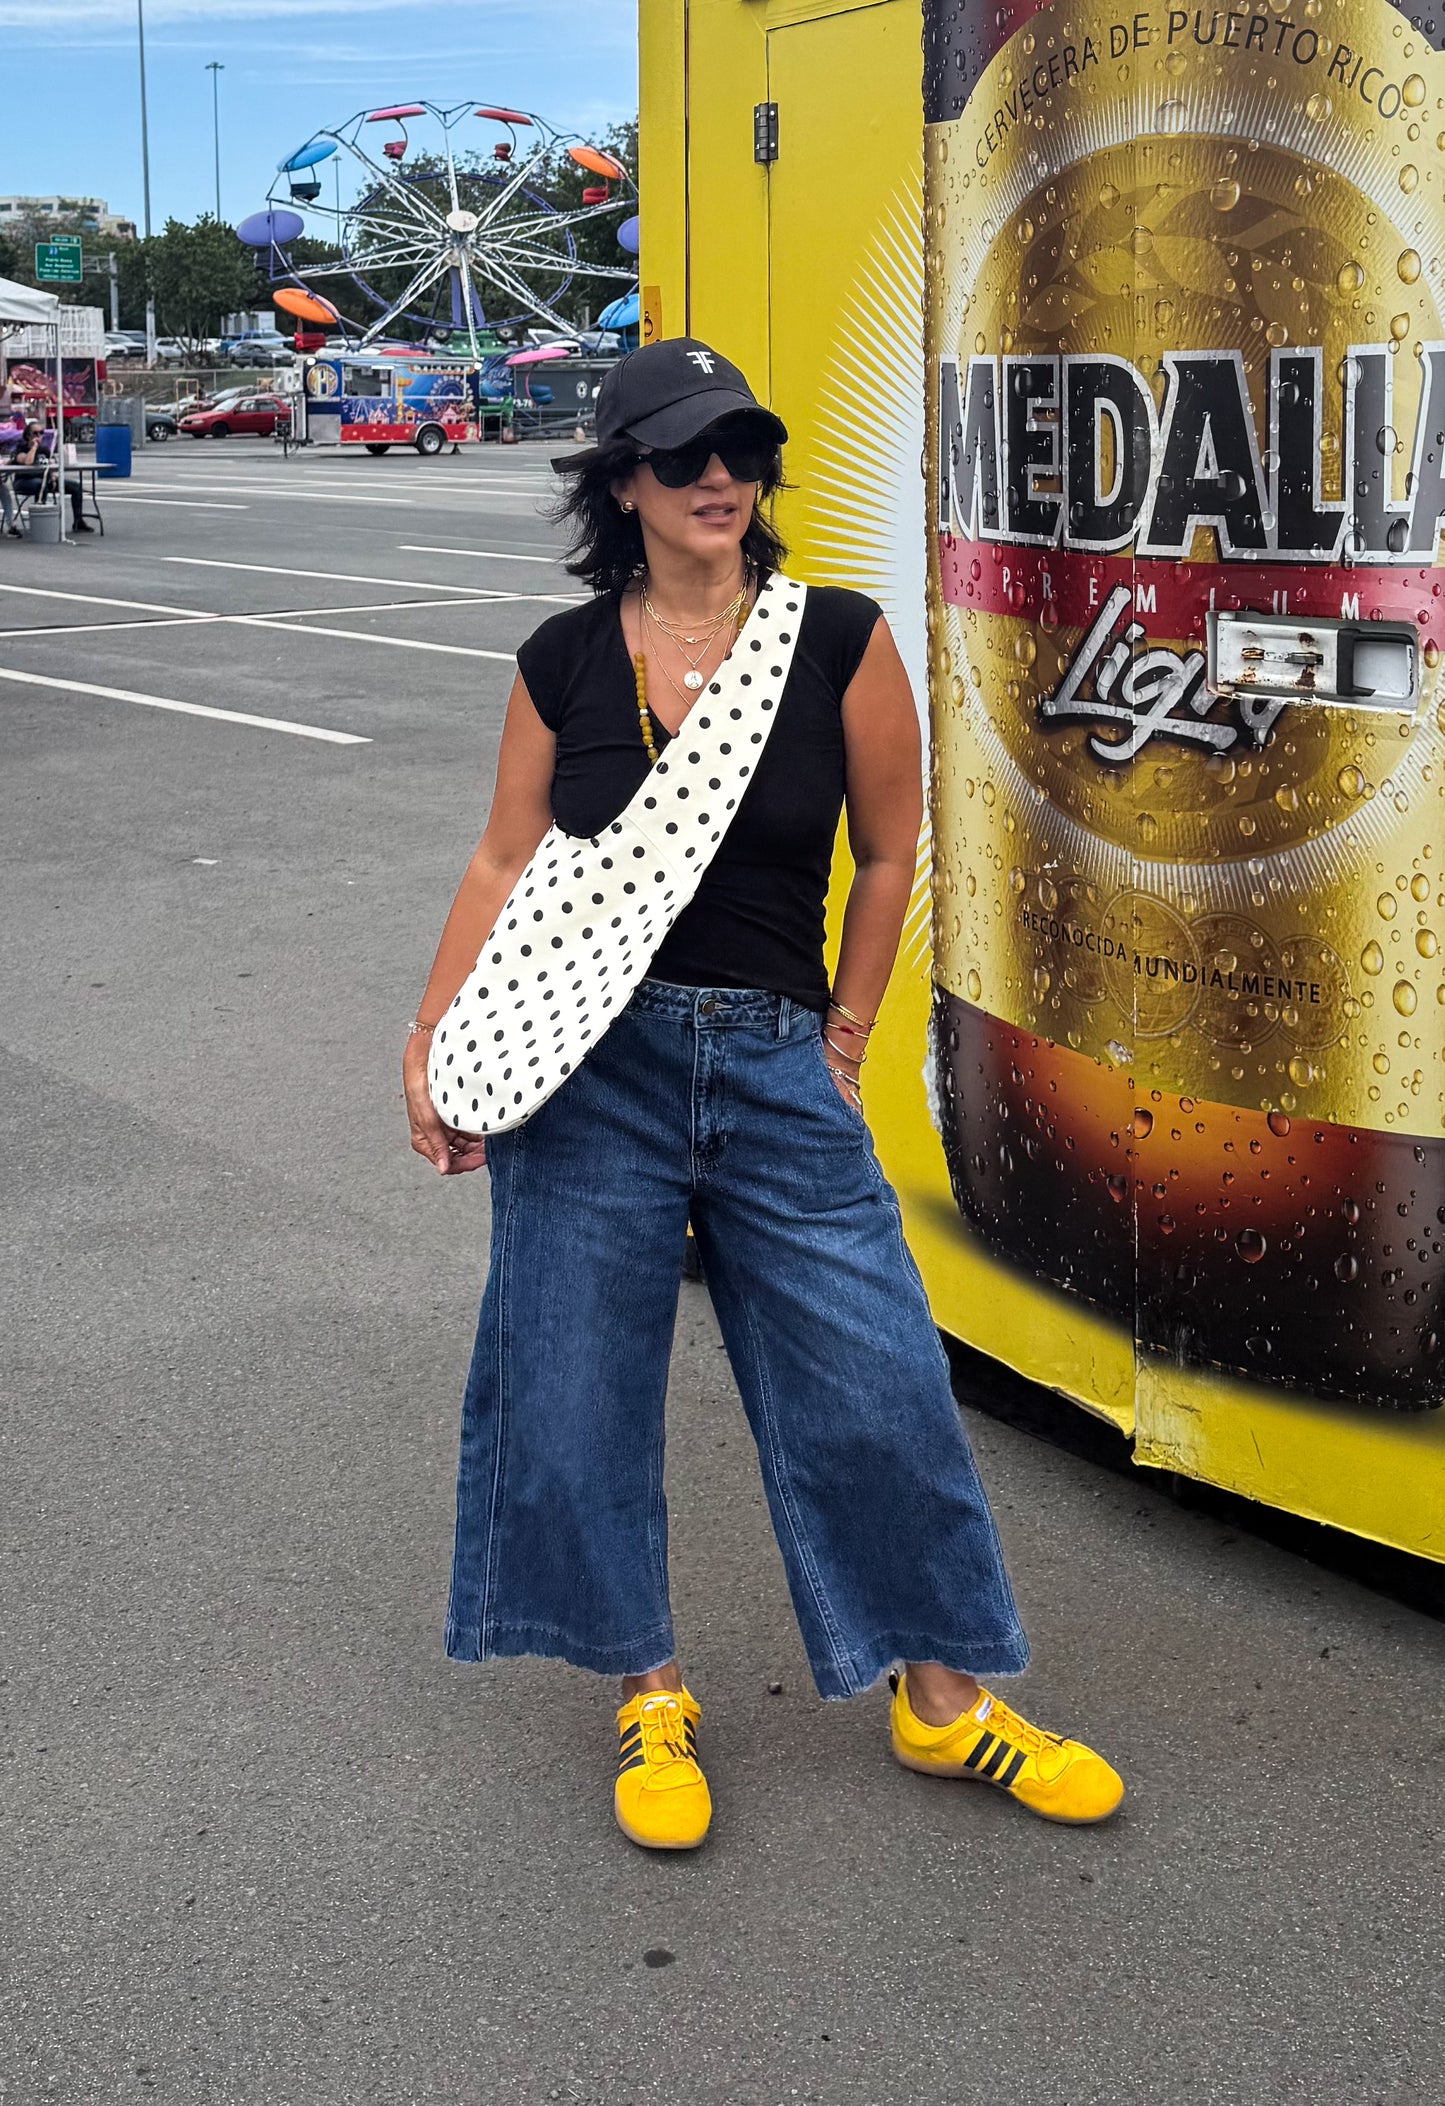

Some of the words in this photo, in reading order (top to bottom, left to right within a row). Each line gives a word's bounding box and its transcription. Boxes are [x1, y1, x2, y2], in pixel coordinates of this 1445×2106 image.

[975, 36, 1098, 168] CERVECERA
[1110, 13, 1150, 59] DE
[1167, 10, 1318, 65] PUERTO
[1326, 43, 1401, 119] RICO
[939, 341, 1445, 562] MEDALL
[1002, 567, 1361, 622] PREMIUM
[1042, 586, 1288, 761] Lig
[1022, 909, 1128, 962] RECONOCIDA
